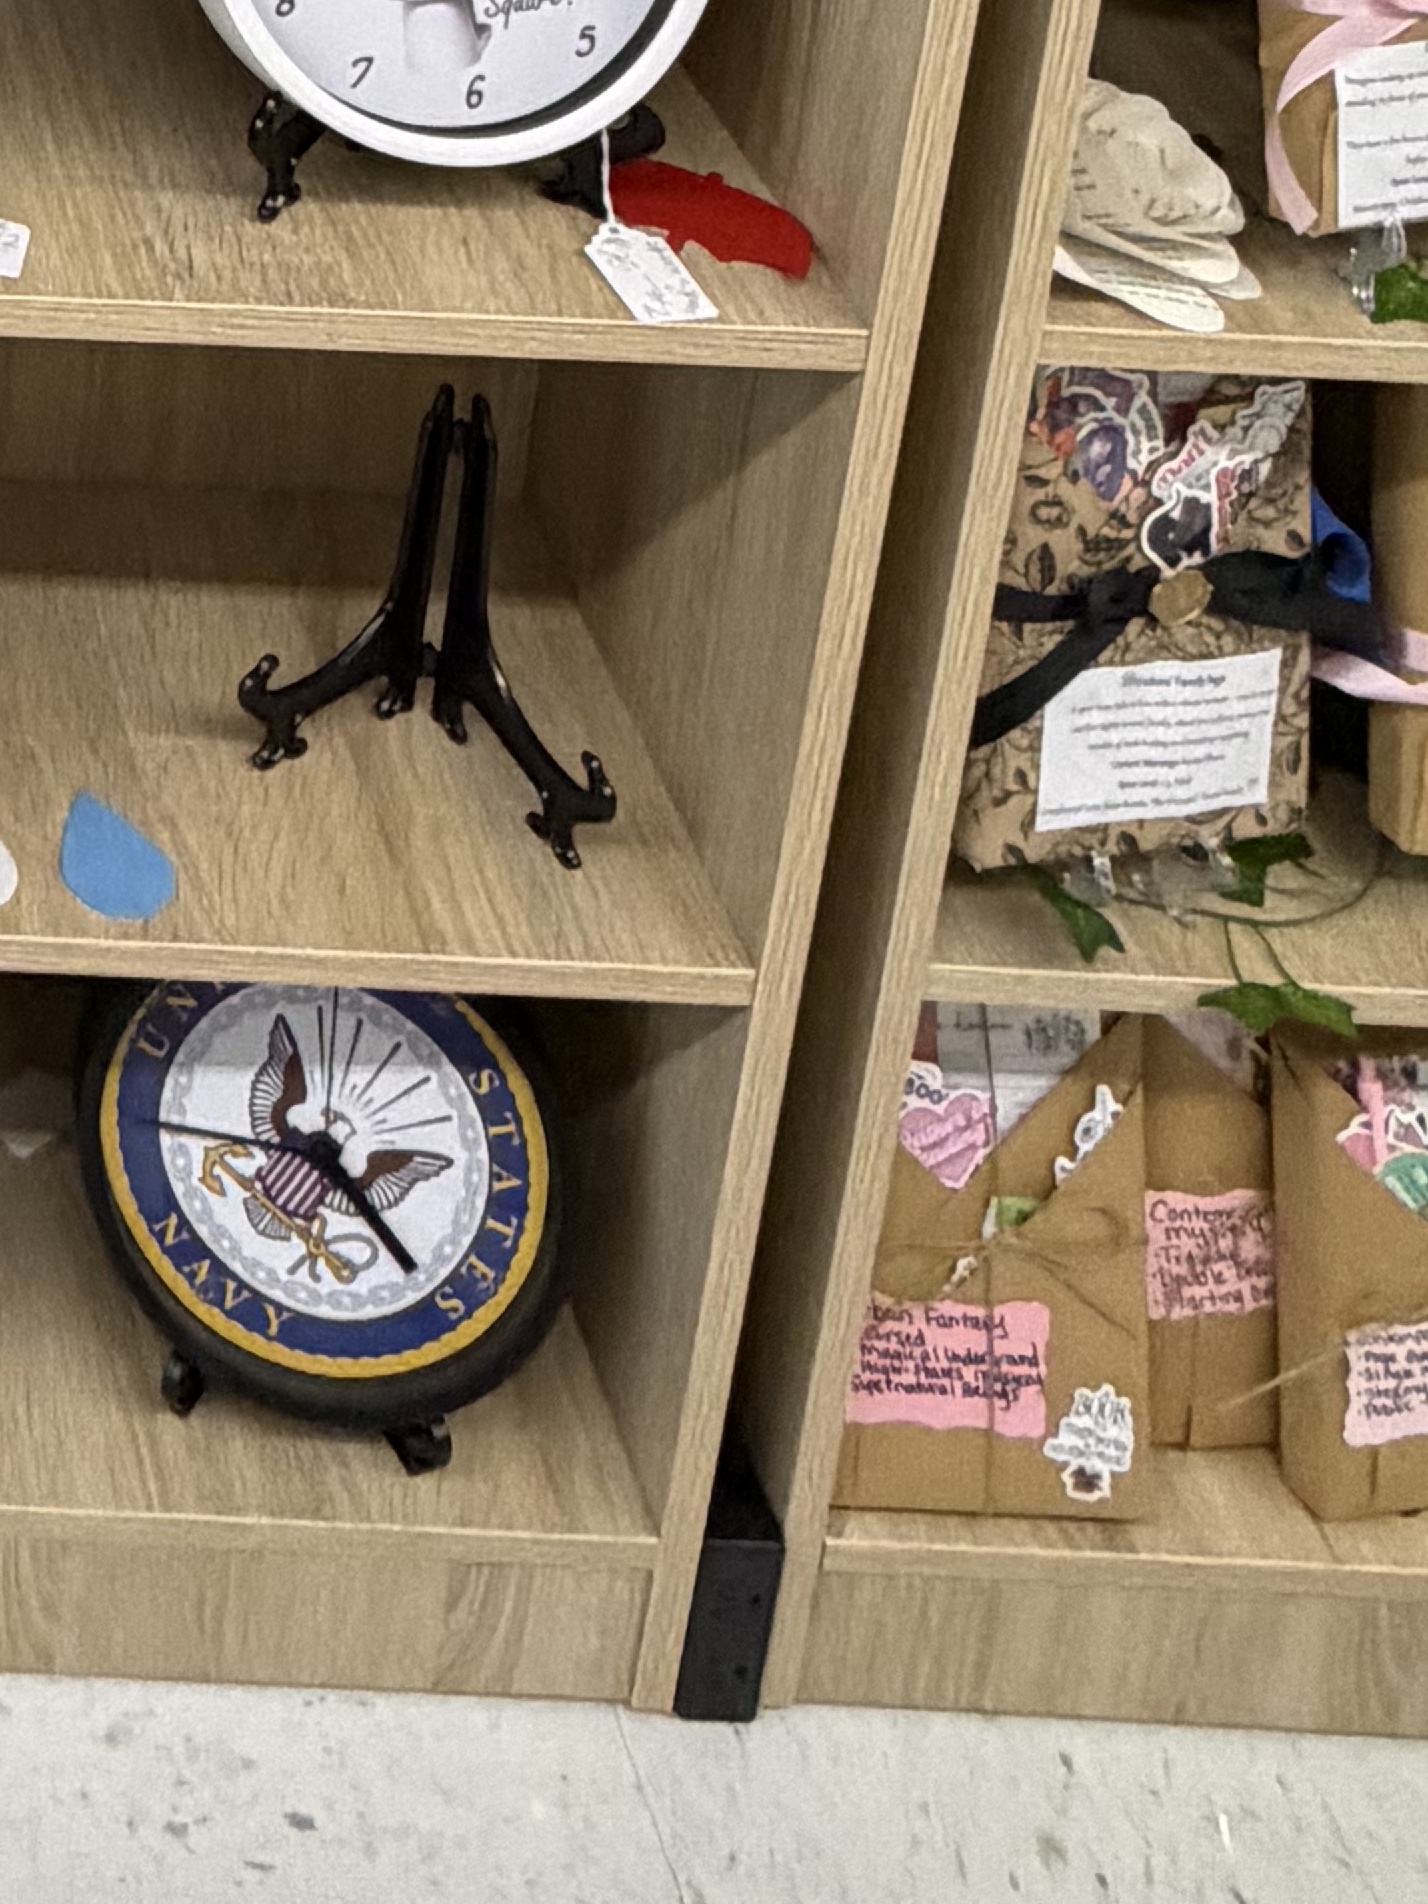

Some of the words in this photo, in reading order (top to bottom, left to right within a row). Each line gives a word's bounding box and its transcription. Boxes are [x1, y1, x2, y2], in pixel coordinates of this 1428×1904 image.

[574, 26, 597, 57] 5
[351, 56, 374, 89] 7
[465, 74, 485, 108] 6
[434, 1068, 523, 1321] STATES
[152, 1212, 292, 1338] NAVY
